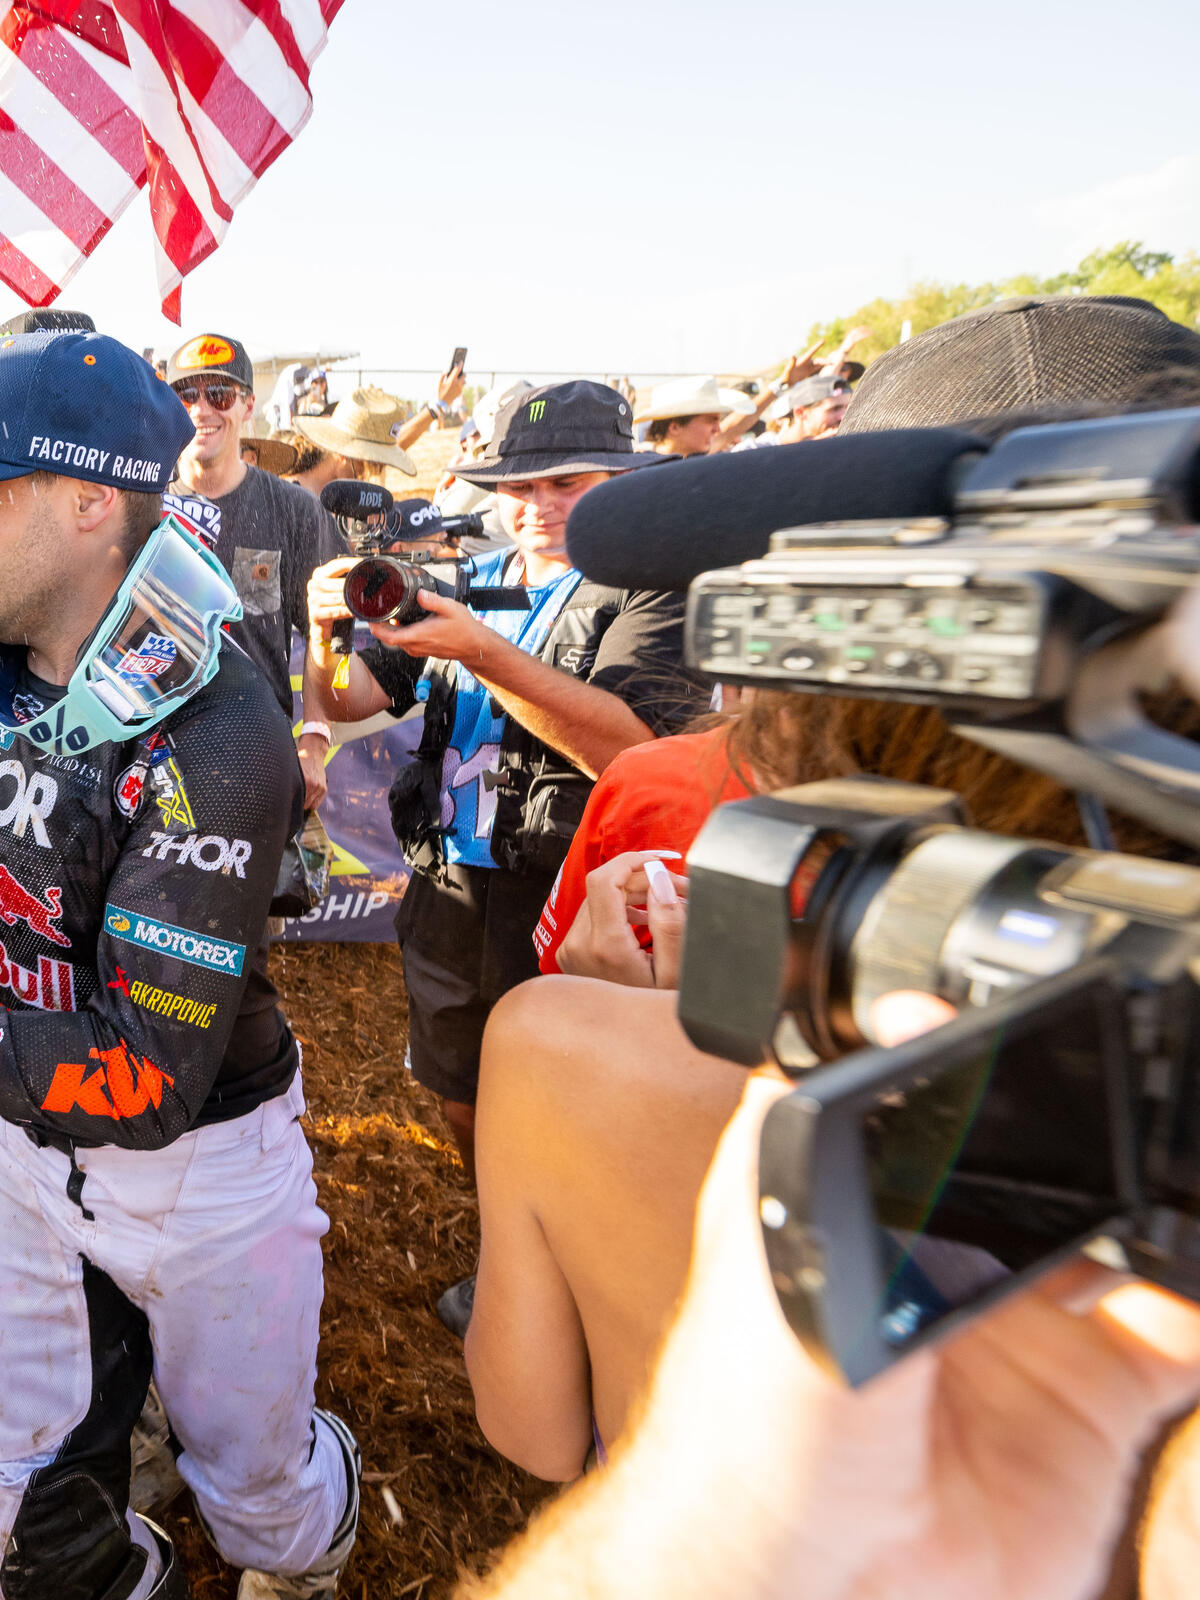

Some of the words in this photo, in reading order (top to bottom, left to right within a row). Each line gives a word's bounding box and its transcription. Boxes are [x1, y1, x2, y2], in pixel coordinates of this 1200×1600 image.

[28, 436, 110, 472] FACTORY
[112, 455, 161, 482] RACING
[141, 831, 253, 880] THOR
[133, 920, 239, 969] MOTOREX
